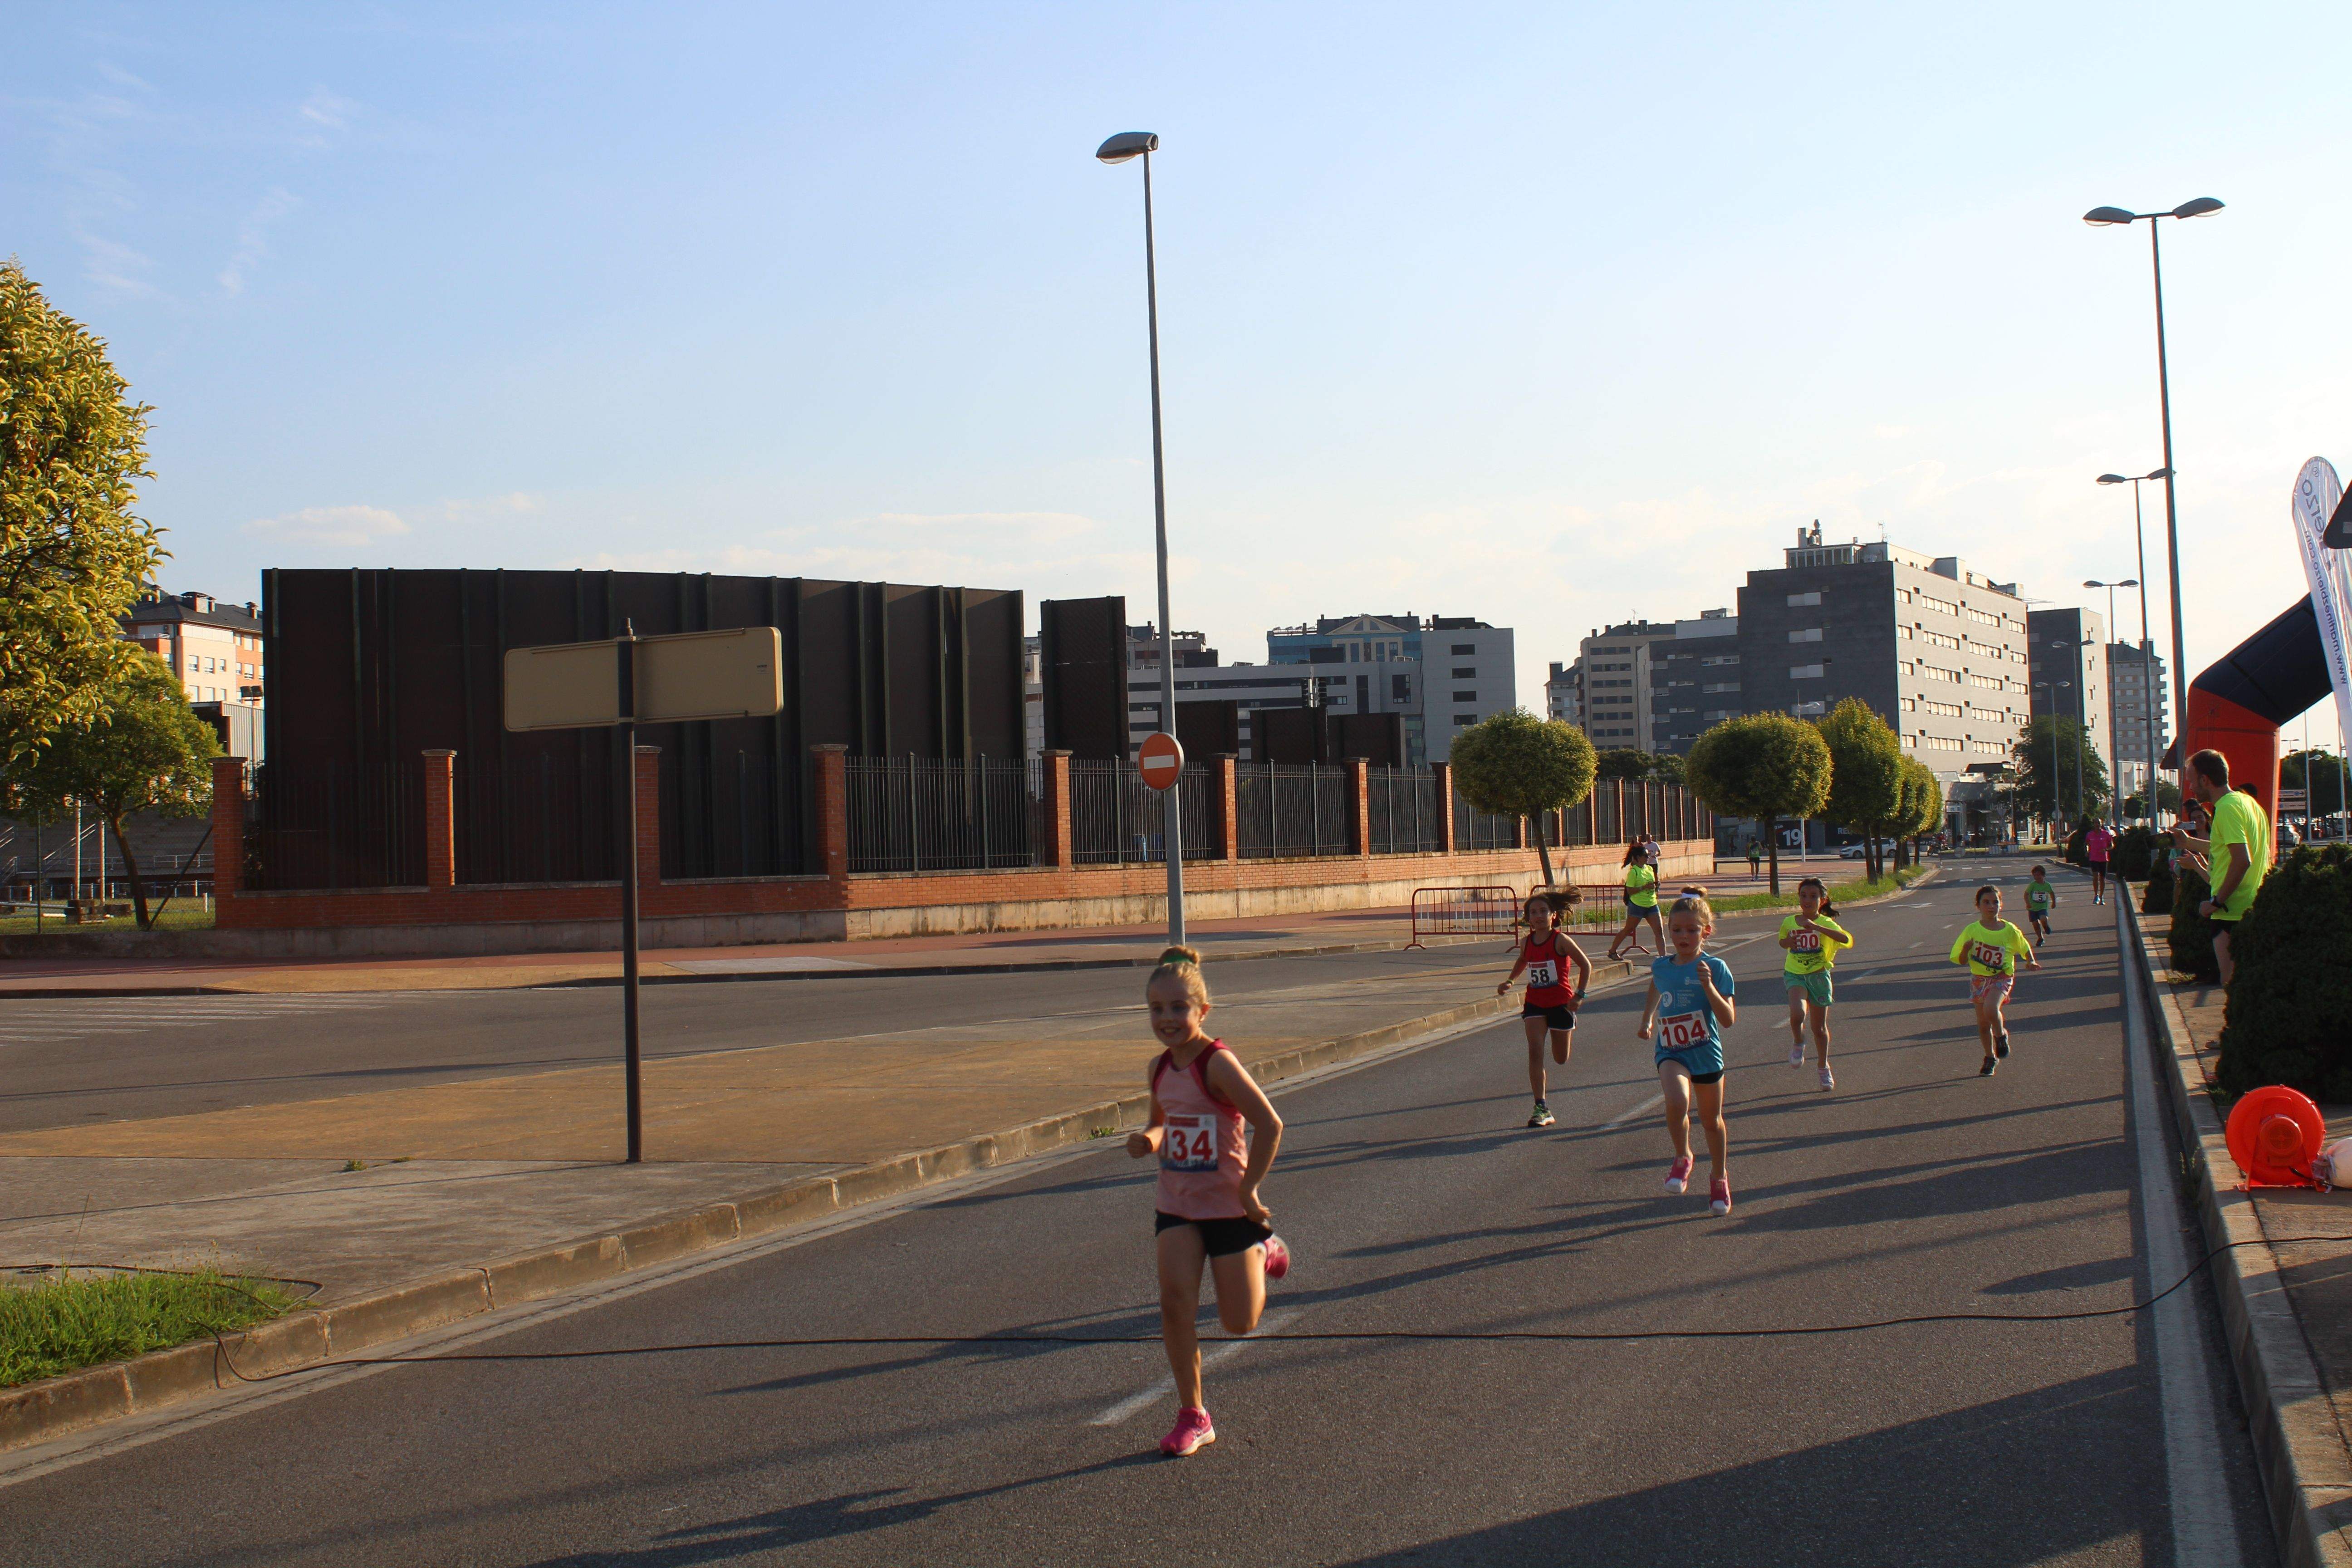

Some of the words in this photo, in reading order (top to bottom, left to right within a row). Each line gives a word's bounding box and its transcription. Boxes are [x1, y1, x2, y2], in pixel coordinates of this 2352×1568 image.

[1783, 829, 1801, 846] 19
[1975, 946, 2002, 965] 103
[1531, 969, 1550, 984] 58
[1662, 1019, 1706, 1047] 104
